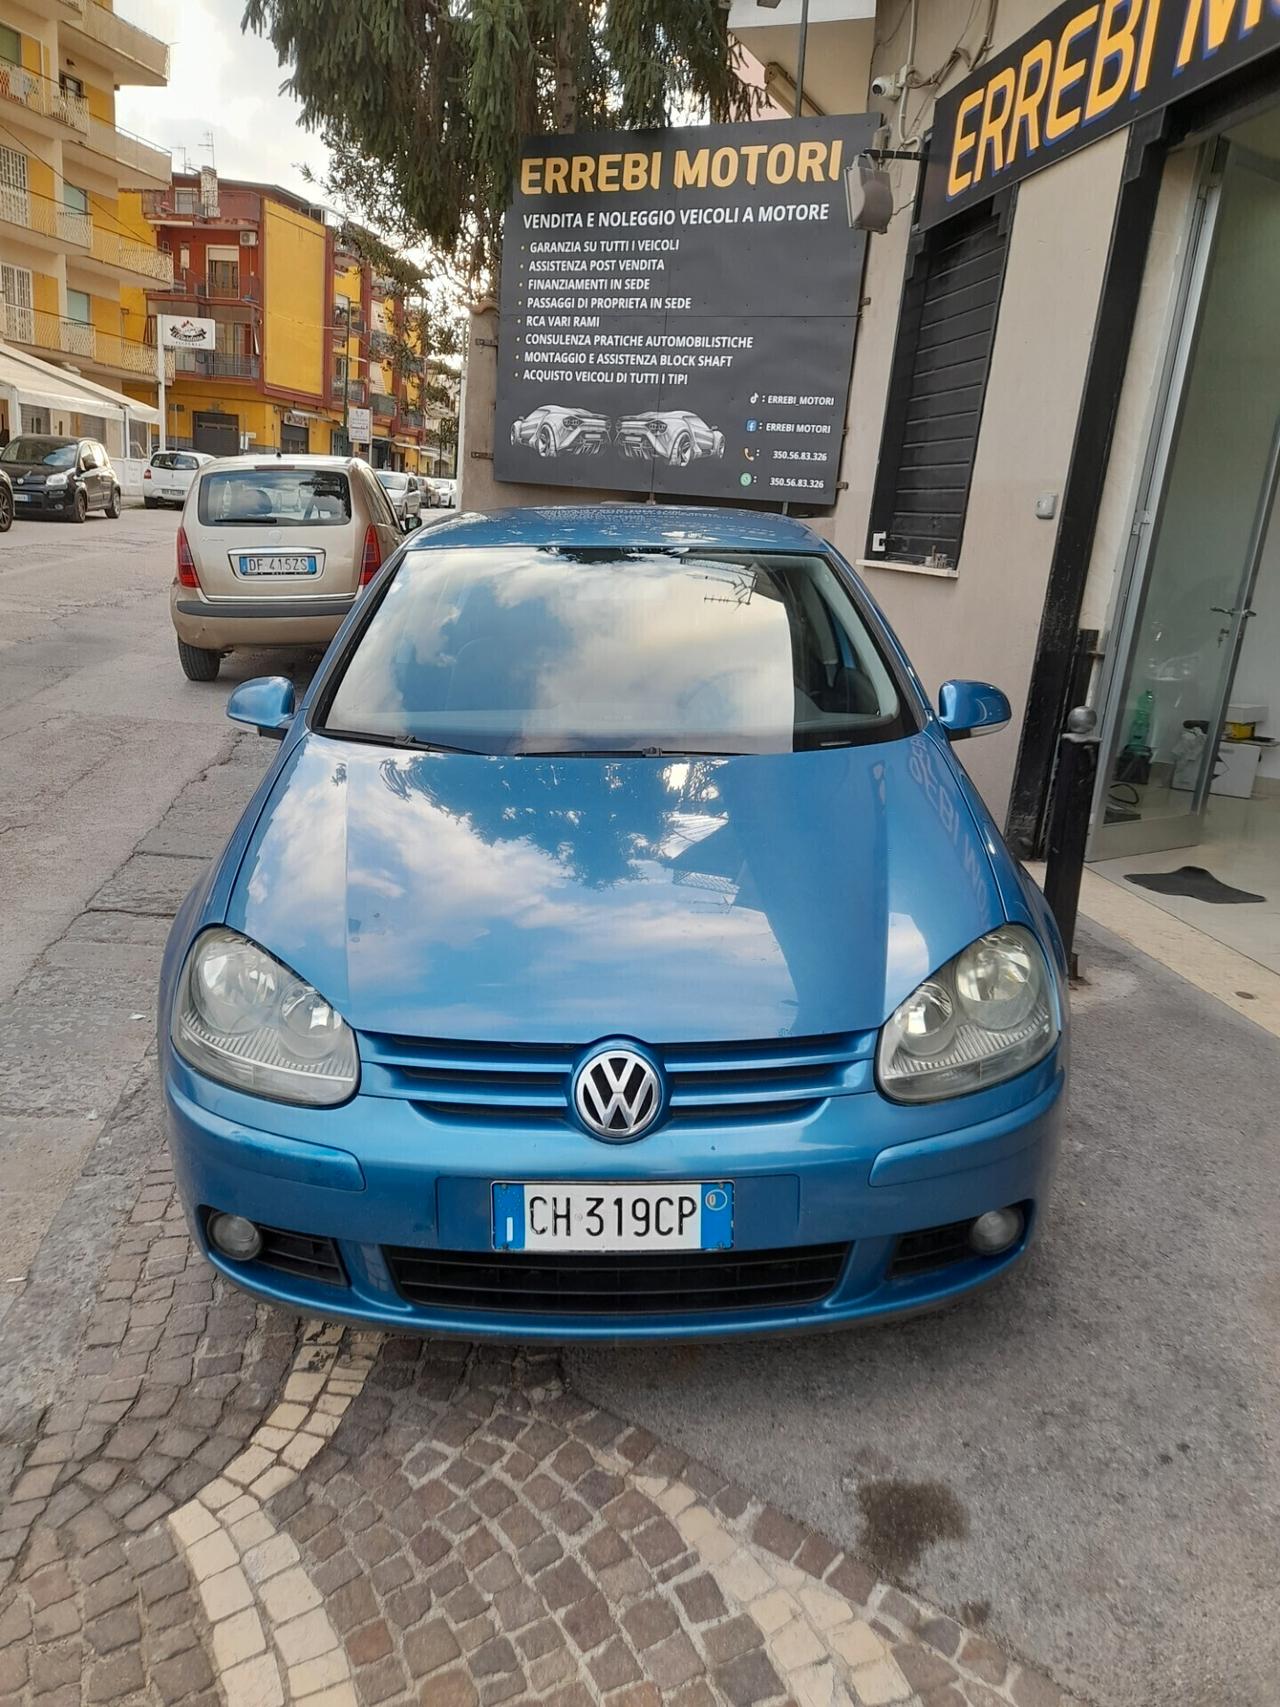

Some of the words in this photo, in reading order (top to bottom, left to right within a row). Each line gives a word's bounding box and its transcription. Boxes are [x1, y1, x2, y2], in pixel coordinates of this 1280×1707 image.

[947, 0, 1161, 199] ERREBI
[520, 151, 662, 195] ERREBI
[673, 140, 843, 189] MOTORI
[523, 212, 583, 229] VENDITA
[586, 212, 595, 228] E
[598, 209, 676, 227] NOLEGGIO
[679, 207, 739, 225] VEICOLI
[742, 207, 755, 223] A
[758, 203, 830, 222] MOTORE
[530, 241, 581, 253] GARANZIA
[583, 241, 597, 252] SU
[600, 240, 631, 252] TUTTI
[631, 240, 636, 251] I
[637, 239, 680, 251] VEICOLI
[528, 259, 588, 271] ASSISTENZA
[589, 259, 617, 271] POST
[619, 259, 665, 271] VENDITA
[527, 278, 608, 290] FINANZIAMENTI
[609, 278, 623, 290] IN
[624, 278, 651, 290] SEDE
[527, 297, 575, 309] PASSAGGI
[577, 298, 589, 309] DI
[591, 297, 648, 309] PROPRIETA
[650, 298, 663, 309] IN
[664, 298, 692, 309] SEDE
[526, 315, 546, 327] RCA
[547, 315, 571, 327] VARI
[573, 316, 600, 328] RAMI
[525, 333, 591, 346] CONSULENZA
[593, 334, 644, 347] PRATICHE
[645, 335, 754, 349] AUTOMOBILISTICHE
[524, 352, 587, 364] MONTAGGIO
[589, 353, 595, 364] E
[596, 353, 658, 366] ASSISTENZA
[659, 355, 696, 367] BLOCK
[697, 355, 734, 368] SHAFT
[523, 370, 573, 383] ACQUISTO
[574, 370, 614, 383] VEICOLI
[616, 372, 628, 383] DI
[629, 372, 659, 384] TUTTI
[660, 373, 666, 384] I
[667, 373, 689, 385] TIPI
[765, 422, 795, 432] ERREBI
[796, 424, 831, 434] MOTORI
[772, 450, 828, 461] 350.56.83.326
[769, 477, 825, 488] 350.56.83.326
[248, 558, 265, 571] DF
[269, 558, 308, 571] 415ZS
[529, 1196, 571, 1237] CH
[585, 1196, 697, 1237] 319CP
